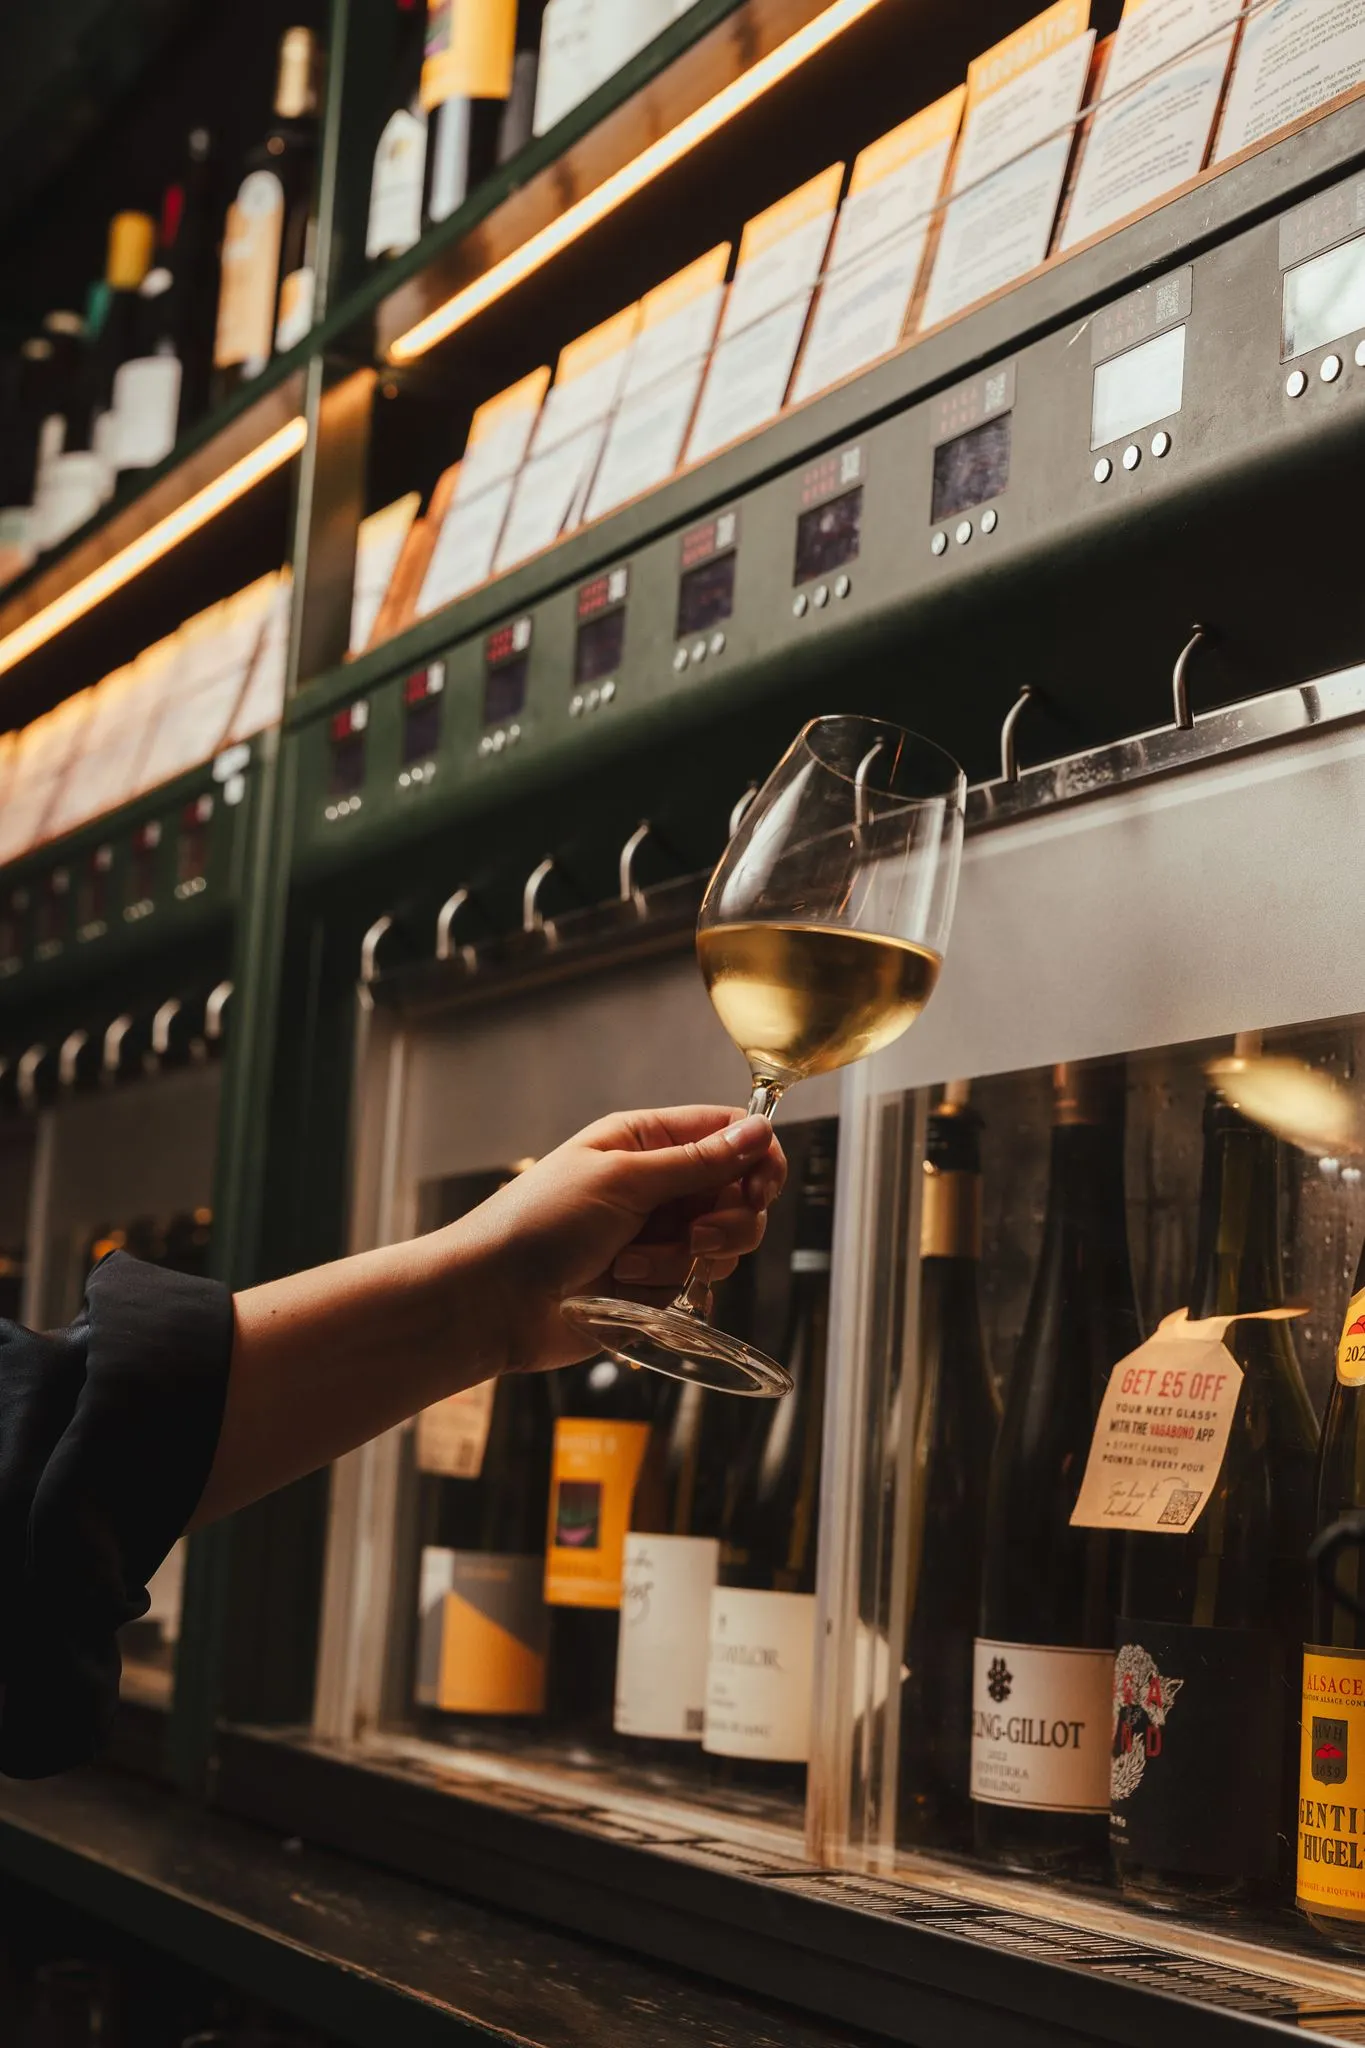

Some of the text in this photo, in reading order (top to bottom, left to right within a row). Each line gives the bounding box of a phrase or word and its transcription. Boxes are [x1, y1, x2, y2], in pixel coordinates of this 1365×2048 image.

[1121, 1368, 1228, 1401] GET £5 OFF
[1116, 1403, 1142, 1414] YOUR
[1145, 1405, 1173, 1417] NEXT
[1110, 1419, 1216, 1442] WITH THE VAGABOND APP
[1102, 1453, 1134, 1465] POINTS
[1150, 1459, 1179, 1470] EVERY
[1180, 1462, 1205, 1472] POUR
[1307, 1673, 1363, 1696] ALSACE
[1299, 1798, 1365, 1835] GENTI
